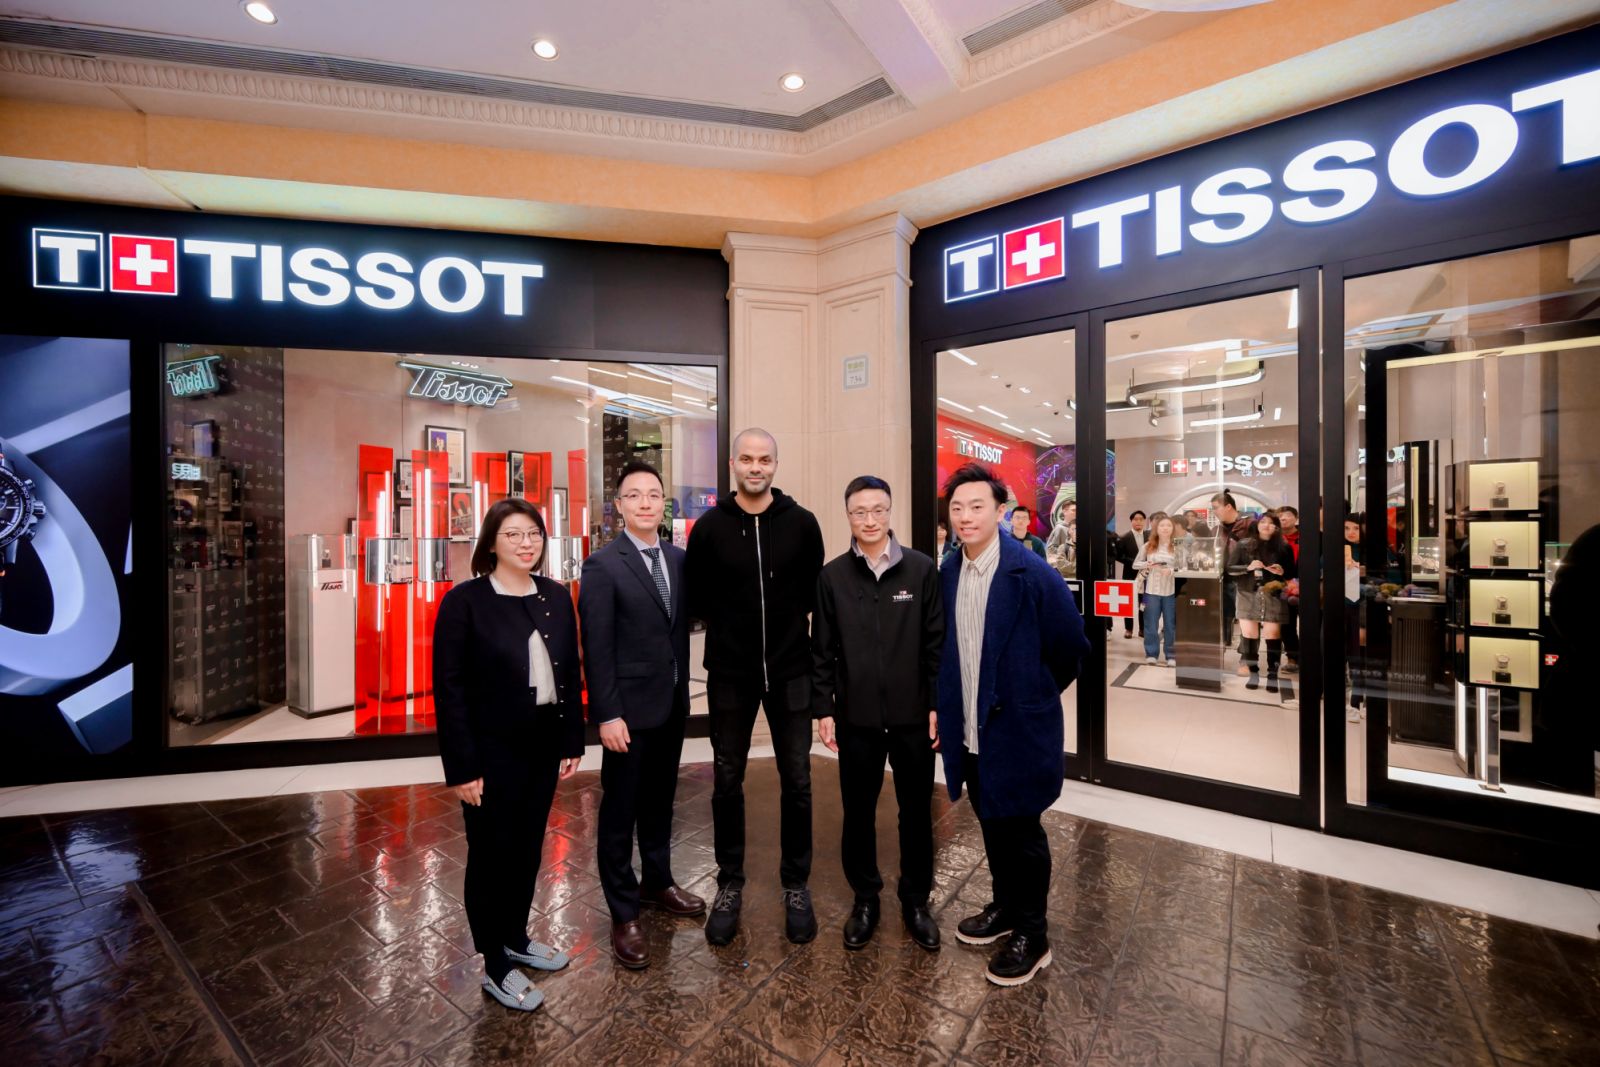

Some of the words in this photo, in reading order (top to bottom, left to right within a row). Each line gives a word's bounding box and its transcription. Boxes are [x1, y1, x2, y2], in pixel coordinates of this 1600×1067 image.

[1073, 72, 1600, 268] TISSOT
[184, 239, 543, 316] TISSOT
[398, 362, 513, 406] Tissot
[973, 441, 1002, 464] TISSOT
[1190, 452, 1294, 472] TISSOT
